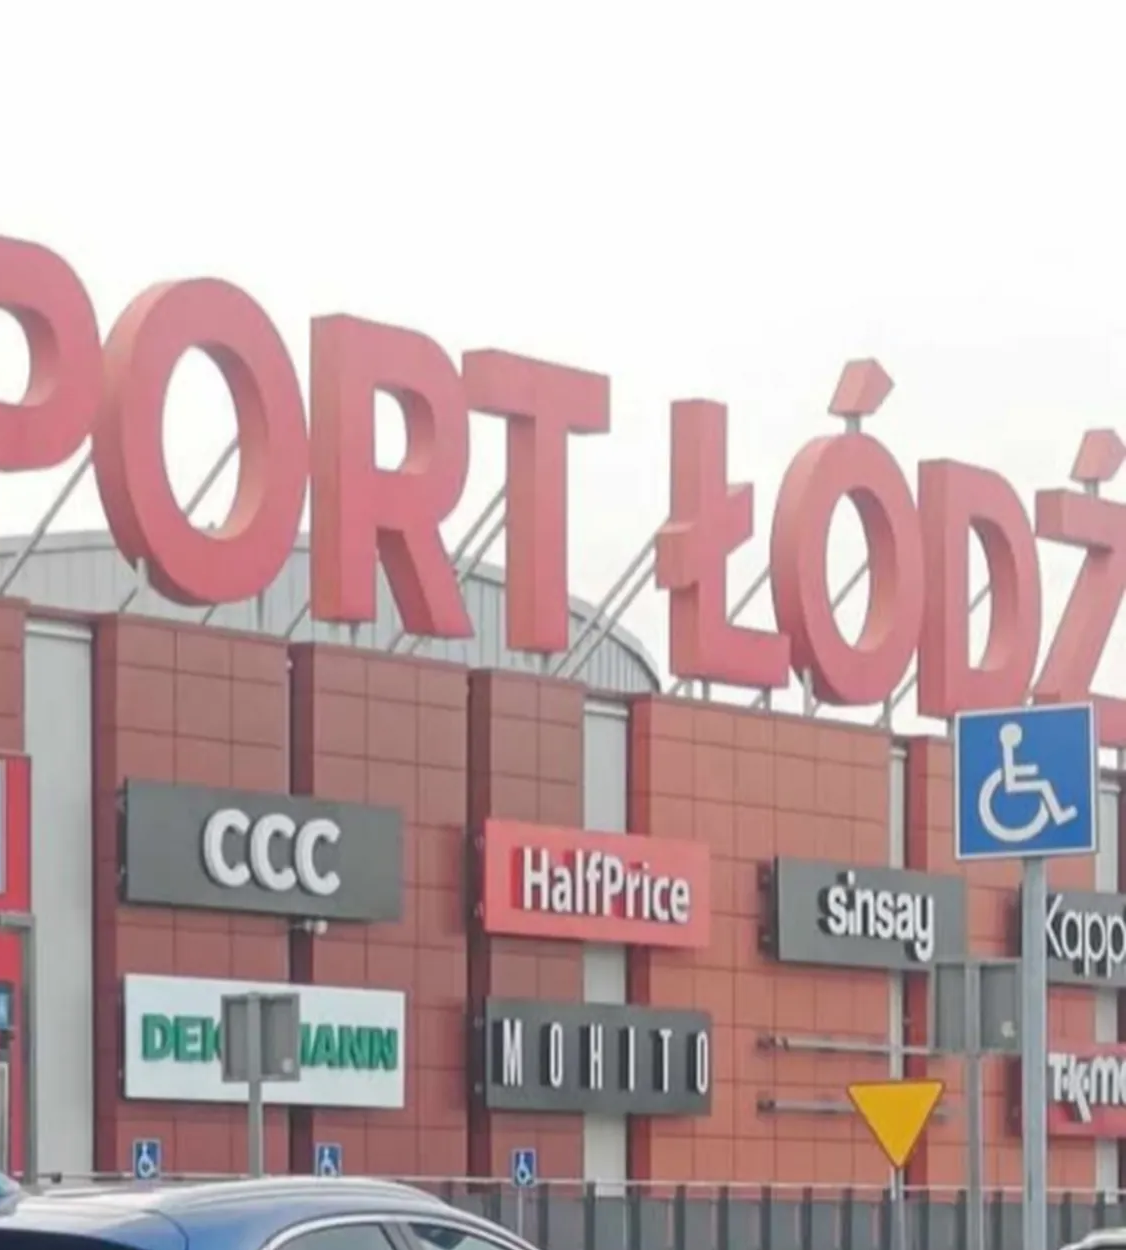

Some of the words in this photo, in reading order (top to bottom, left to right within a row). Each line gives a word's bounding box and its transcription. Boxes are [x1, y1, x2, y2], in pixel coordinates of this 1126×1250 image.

[655, 357, 1126, 749] ŁÓDŹ
[203, 807, 341, 895] CCC
[522, 846, 692, 924] HalfPrice
[827, 870, 935, 962] sinsay
[141, 1013, 398, 1071] DEIANN
[502, 1018, 709, 1095] MOHITO
